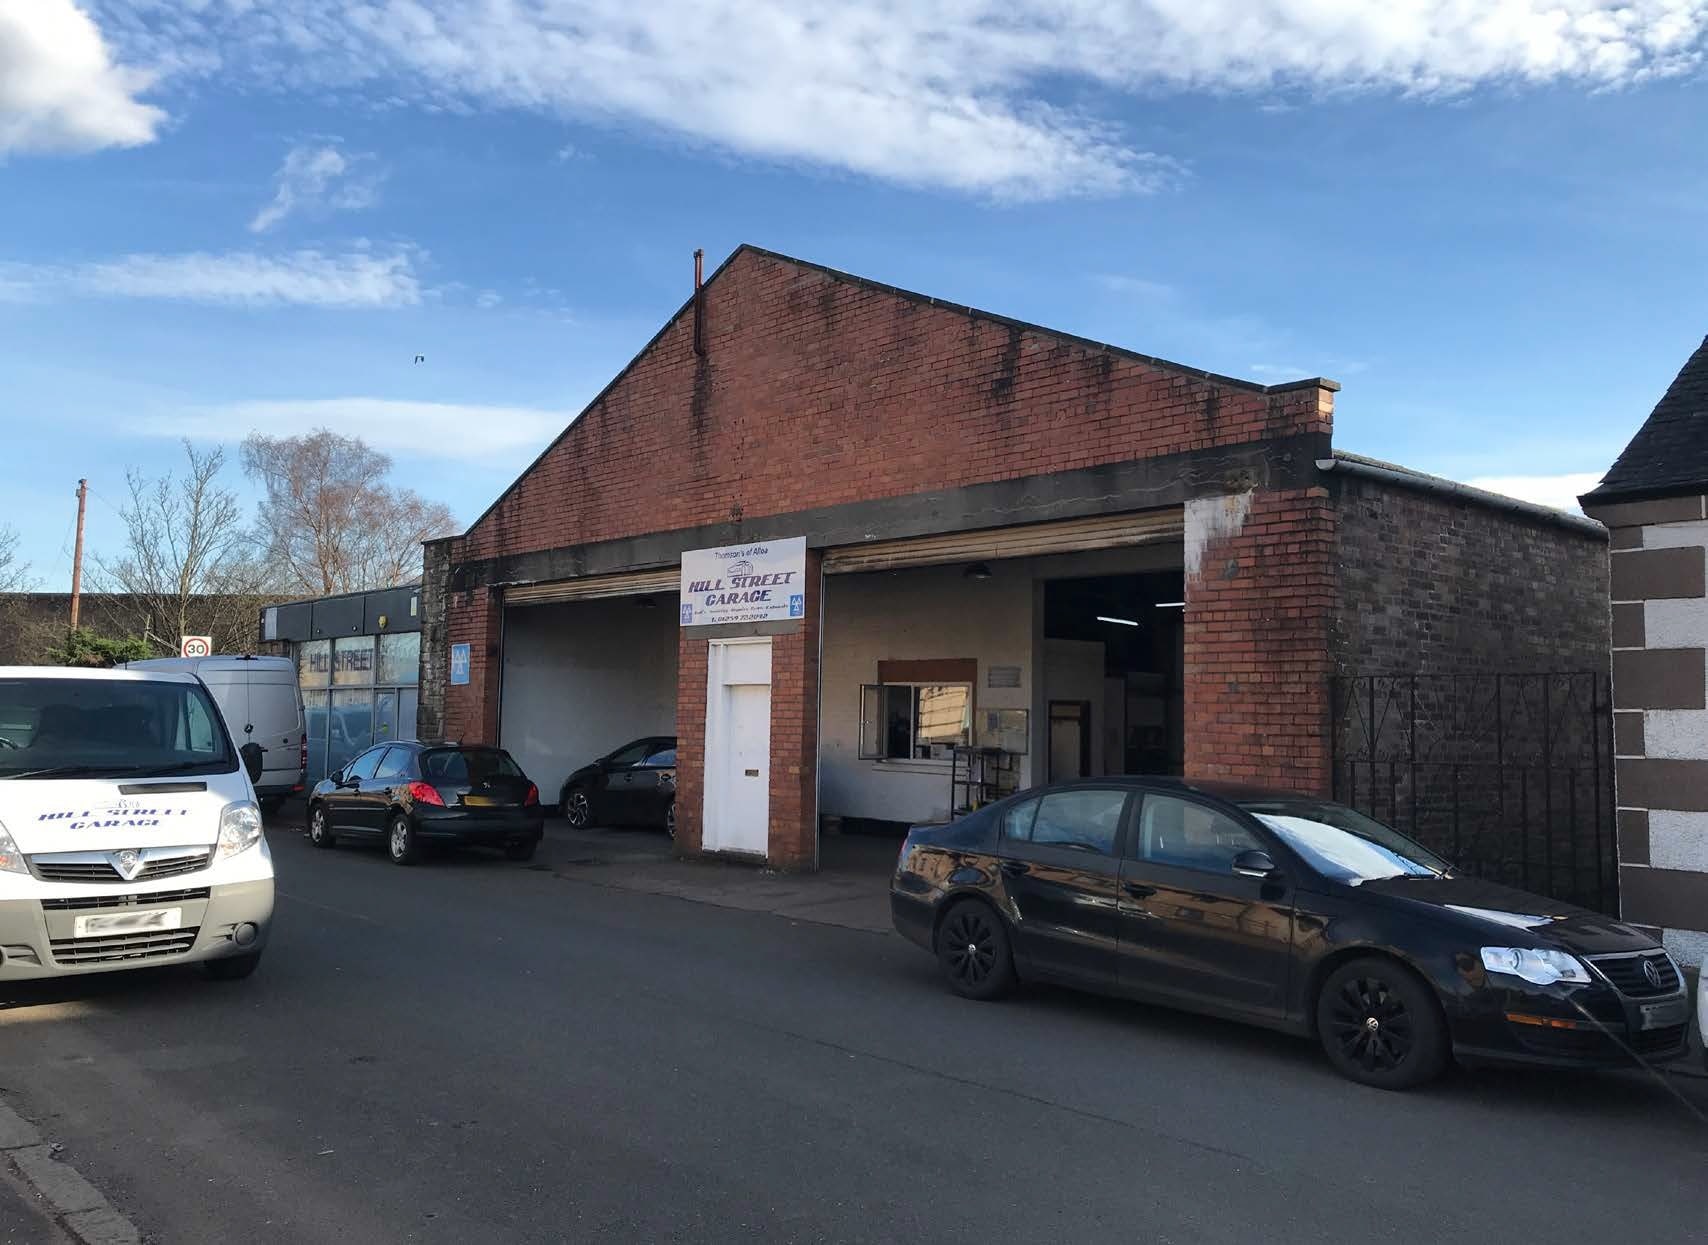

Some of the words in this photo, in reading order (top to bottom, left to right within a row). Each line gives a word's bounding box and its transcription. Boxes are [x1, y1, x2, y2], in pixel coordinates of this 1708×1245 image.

[688, 580, 726, 593] HILL
[730, 572, 797, 590] STREET
[705, 590, 772, 607] GARAGE
[188, 645, 205, 654] 30
[70, 820, 161, 830] GARAGE
